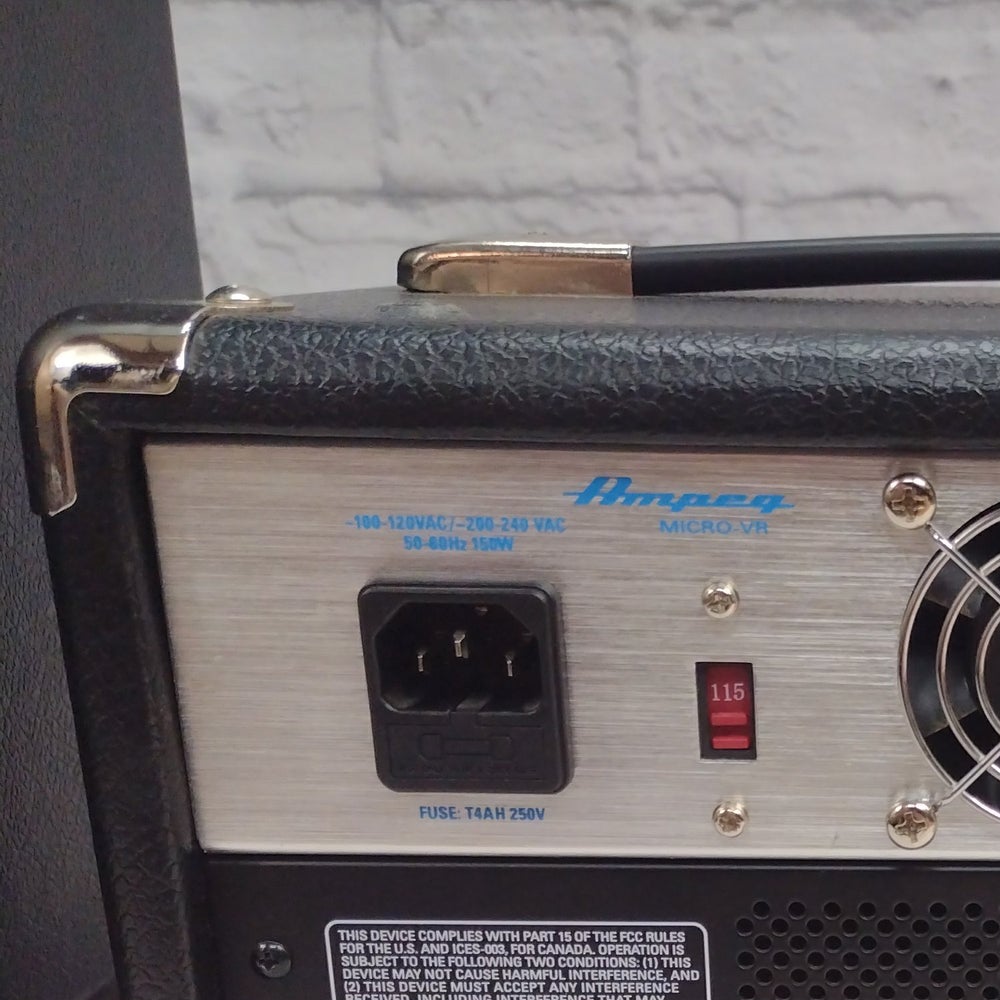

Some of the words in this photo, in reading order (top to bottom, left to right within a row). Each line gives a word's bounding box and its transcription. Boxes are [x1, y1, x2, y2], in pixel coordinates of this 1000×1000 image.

[563, 477, 794, 513] Ampeg
[533, 518, 567, 533] VAC
[659, 520, 768, 534] MICRO-VR
[403, 535, 467, 551] 50-60Hz
[472, 536, 514, 551] 150W
[712, 683, 745, 701] 115
[419, 806, 460, 820] FUSE:
[465, 807, 506, 820] T4AH
[509, 807, 545, 820] 250V
[338, 930, 368, 941] THIS
[370, 930, 416, 942] DEVICE
[418, 930, 483, 942] COMPLIES
[485, 931, 520, 942] WITH
[523, 931, 555, 942] PART
[558, 931, 572, 942] 15
[574, 931, 592, 942] OF
[592, 931, 618, 942] THE
[620, 931, 643, 942] FCC
[646, 931, 685, 942] RULES
[340, 943, 366, 954] FOR
[367, 943, 391, 954] THE
[394, 943, 418, 954] U.S.
[421, 943, 449, 954] AND
[452, 943, 508, 956] ICES-003,
[512, 944, 535, 955] FOR
[538, 944, 595, 955] CANADA.
[598, 944, 669, 955] OPERATION
[672, 944, 685, 955] IS
[341, 956, 399, 967] SUBJECT
[401, 956, 418, 967] TO
[420, 956, 446, 967] THE
[450, 956, 522, 967] FOLLOWING
[524, 956, 555, 968] TWO
[558, 957, 640, 968] CONDITIONS:
[642, 957, 658, 968] (1)
[661, 957, 691, 968] THIS
[343, 969, 389, 980] DEVICE
[392, 969, 421, 980] MAY
[425, 969, 452, 980] NOT
[455, 969, 499, 980] CAUSE
[503, 969, 566, 980] HARMFUL
[569, 969, 667, 982] INTERFERENCE,
[670, 970, 699, 981] AND
[344, 981, 360, 993] (2)
[363, 981, 395, 993] THIS
[399, 982, 447, 993] DEVICE
[450, 982, 490, 993] MUST
[494, 982, 545, 993] ACCEPT
[549, 982, 578, 993] ANY
[581, 982, 679, 993] INTERFERENCE
